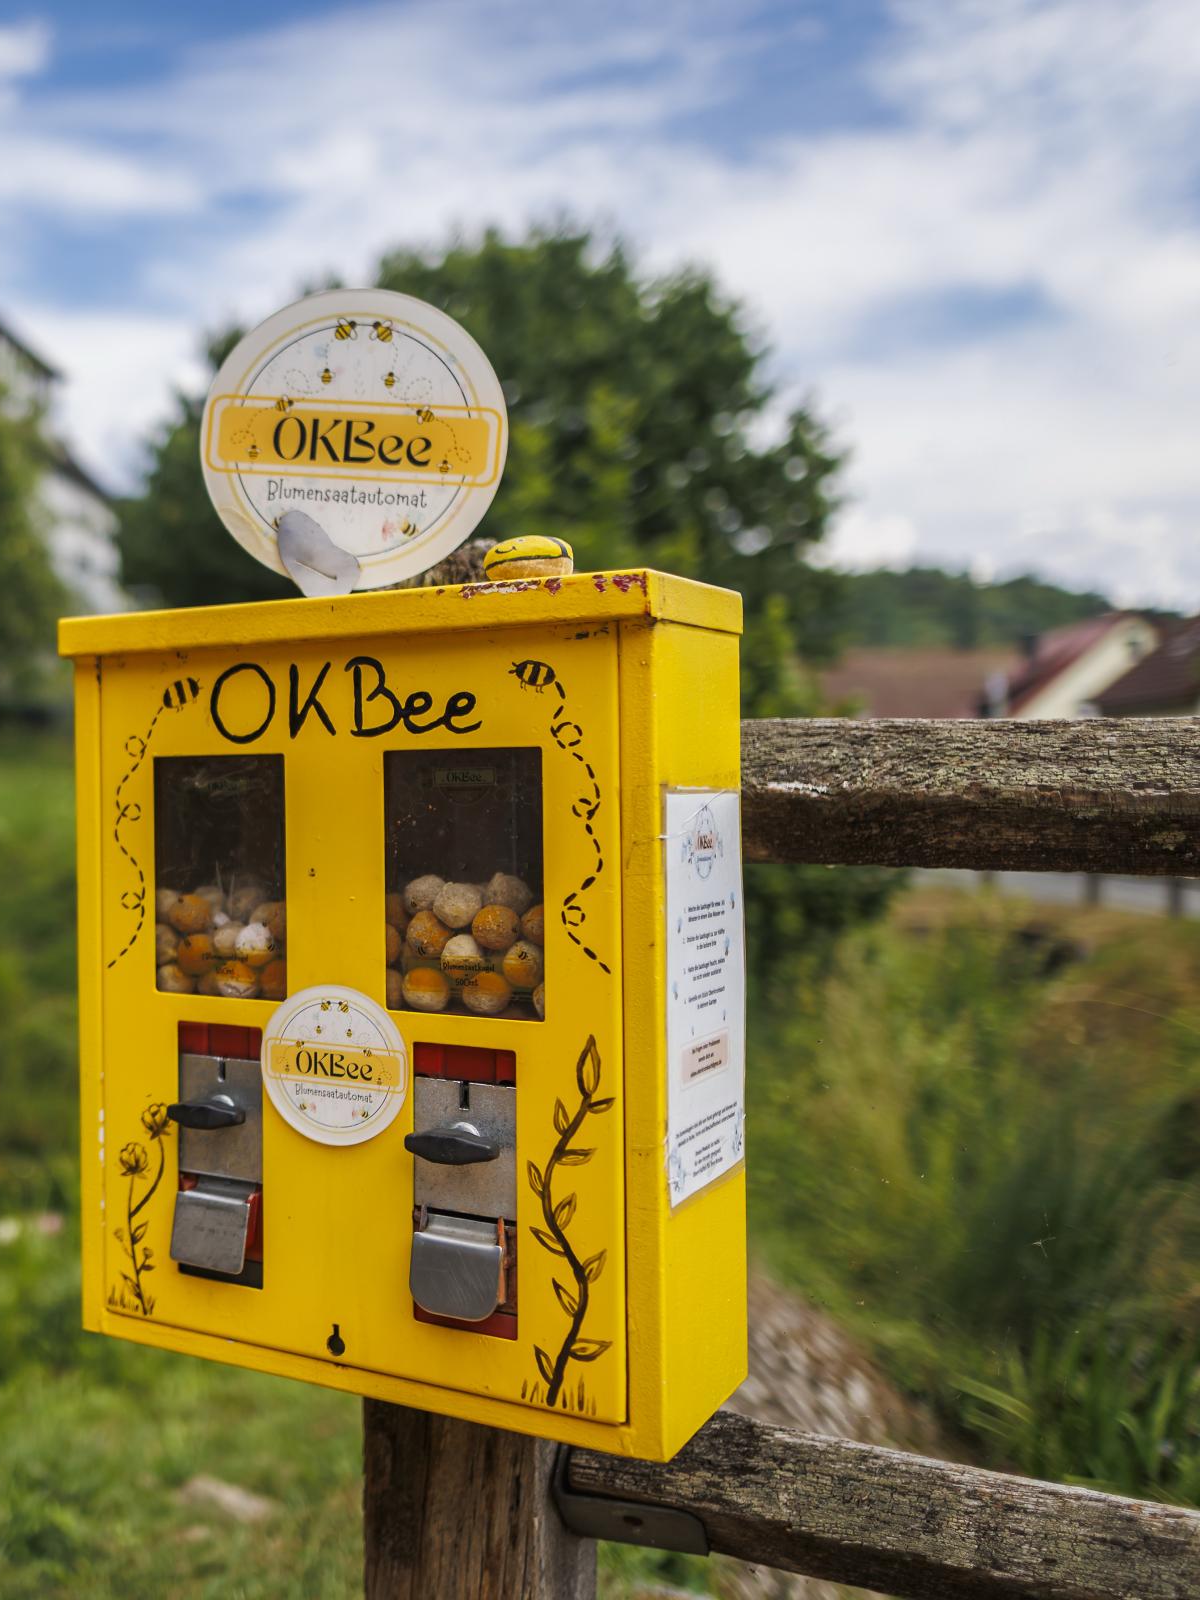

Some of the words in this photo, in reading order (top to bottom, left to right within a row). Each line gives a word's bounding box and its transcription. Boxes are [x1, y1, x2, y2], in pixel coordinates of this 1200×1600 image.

[272, 416, 432, 467] OKBee
[266, 478, 428, 508] Blumensaatautomat
[210, 656, 482, 744] OKBee
[295, 1049, 373, 1082] OKBee
[295, 1083, 373, 1103] Blumensaatautomat
